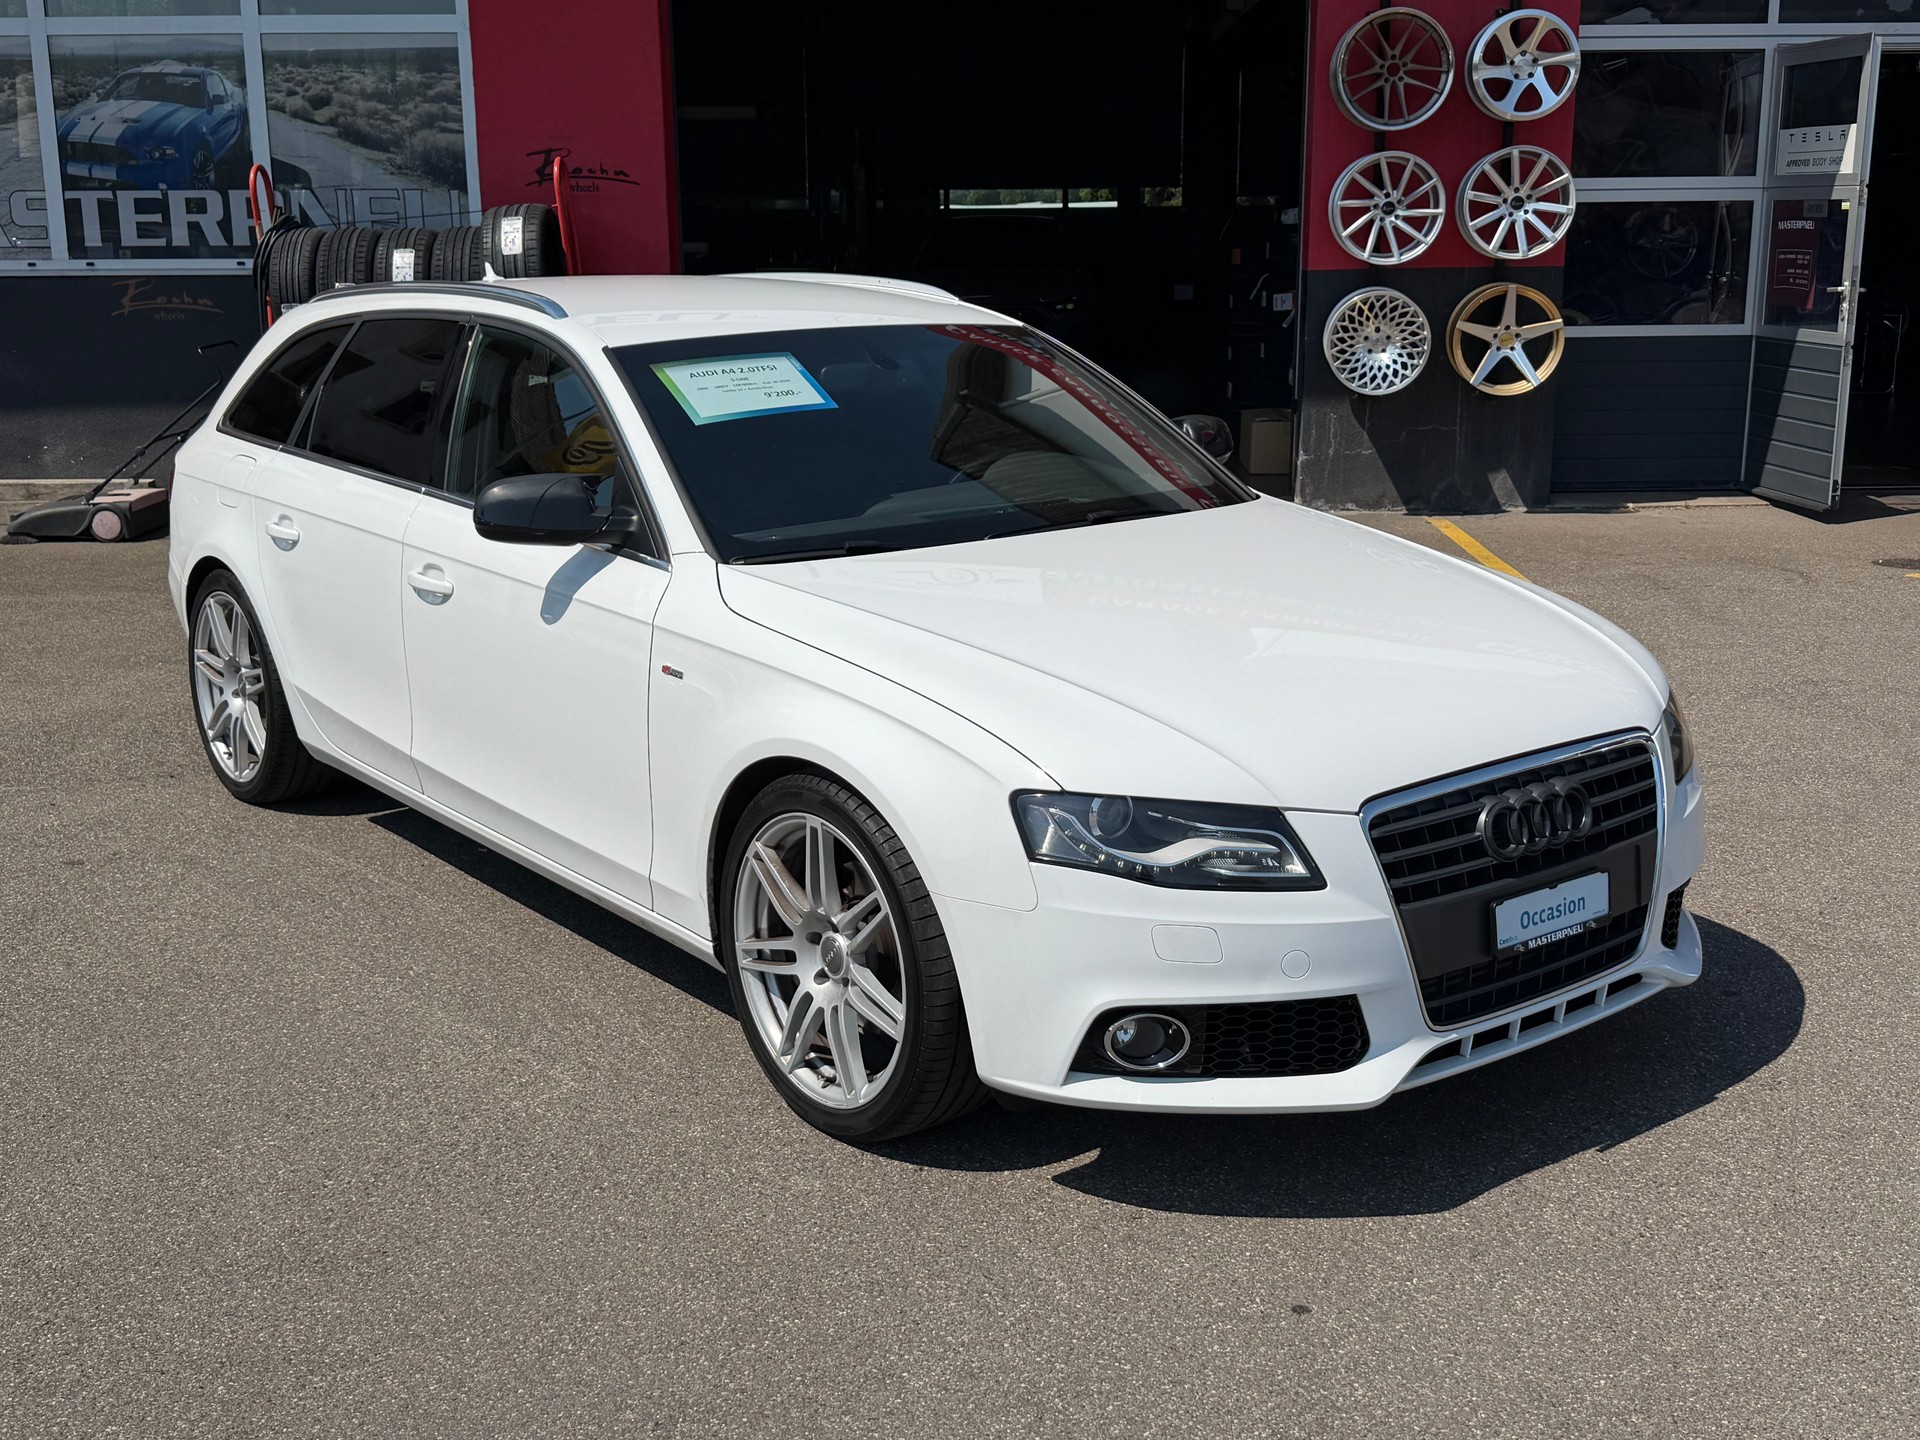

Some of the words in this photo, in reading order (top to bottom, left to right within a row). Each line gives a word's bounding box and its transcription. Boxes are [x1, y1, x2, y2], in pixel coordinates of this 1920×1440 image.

[1789, 129, 1847, 143] TESLA
[1786, 158, 1810, 167] APPROVED
[1812, 156, 1827, 166] BODY
[1777, 220, 1815, 230] MASTERPNEU
[689, 367, 719, 379] AUDI
[721, 367, 736, 376] A4
[737, 364, 778, 374] 2.0TFSI
[763, 389, 802, 398] 9'200.-
[1520, 896, 1586, 930] Occasion
[1528, 923, 1584, 949] MASTERPNEU
